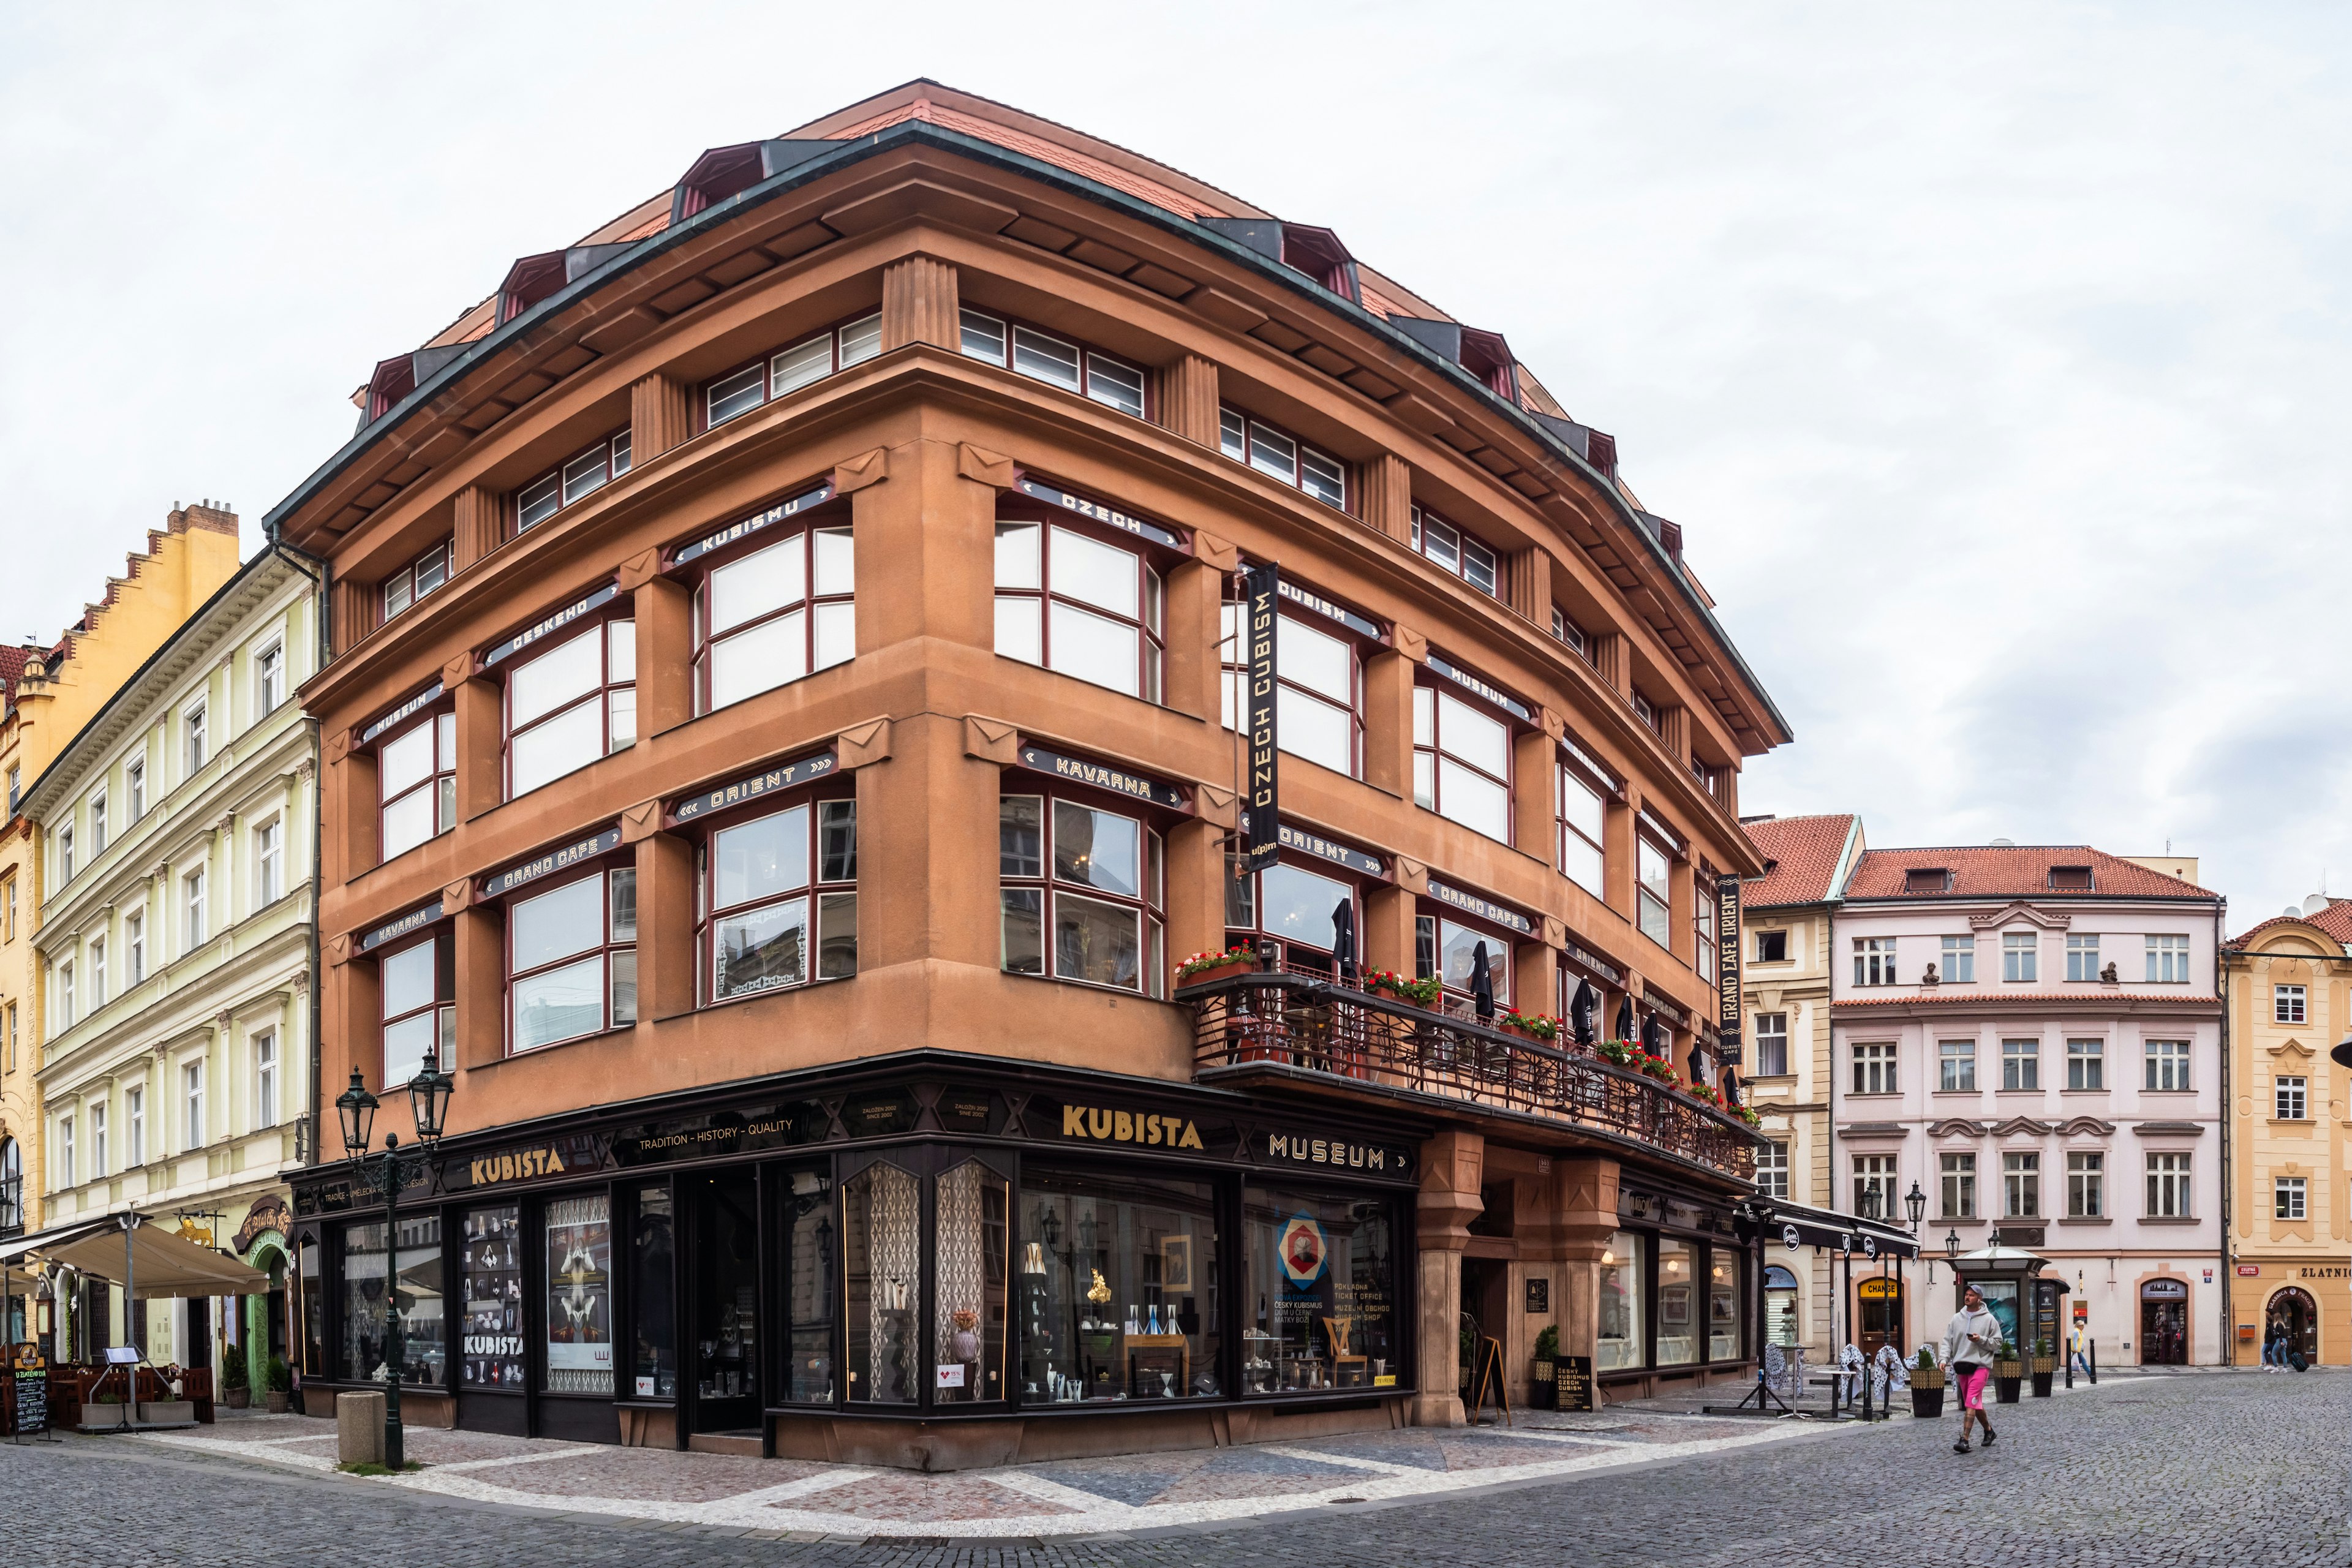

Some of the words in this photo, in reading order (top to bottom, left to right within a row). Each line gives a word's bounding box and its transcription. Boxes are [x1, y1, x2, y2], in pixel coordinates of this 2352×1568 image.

[702, 499, 798, 552] KUBISMU
[1062, 493, 1140, 533] CZECH
[1278, 580, 1345, 622] CUBISM
[1255, 591, 1270, 697] CUBISM
[1451, 667, 1507, 707] MUSEUM
[377, 693, 426, 733] MUSEUM
[1255, 706, 1271, 807] CZECH
[710, 767, 795, 808] ORIENT
[504, 857, 552, 888] GRAND
[558, 839, 598, 866] CAFE
[1251, 842, 1276, 856] u(p)m
[1280, 828, 1349, 862] ORIENT
[1441, 886, 1484, 914] GRAND
[1488, 905, 1519, 928] CAFE
[1721, 894, 1737, 937] ORIENT
[1576, 948, 1605, 974] ORIENT
[1722, 940, 1737, 971] CAFE
[1645, 990, 1664, 1011] GRAND
[1665, 1005, 1679, 1020] CAFE
[1722, 976, 1738, 1020] GRAND
[640, 1134, 687, 1150] TRADITION
[697, 1127, 737, 1142] HISTORY
[748, 1120, 793, 1135] QUALITY
[1063, 1105, 1204, 1150] KUBISTA
[471, 1147, 565, 1185] KUBISTA
[1269, 1134, 1384, 1170] MUSEUM
[325, 1191, 345, 1202] TRADICE
[407, 1177, 428, 1189] DESIGN
[1274, 1300, 1292, 1309] ČESKÝ
[2297, 1291, 2313, 1310] PRAGUE
[464, 1336, 524, 1355] KUBISTA
[20, 1370, 38, 1378] ZLATÉHO
